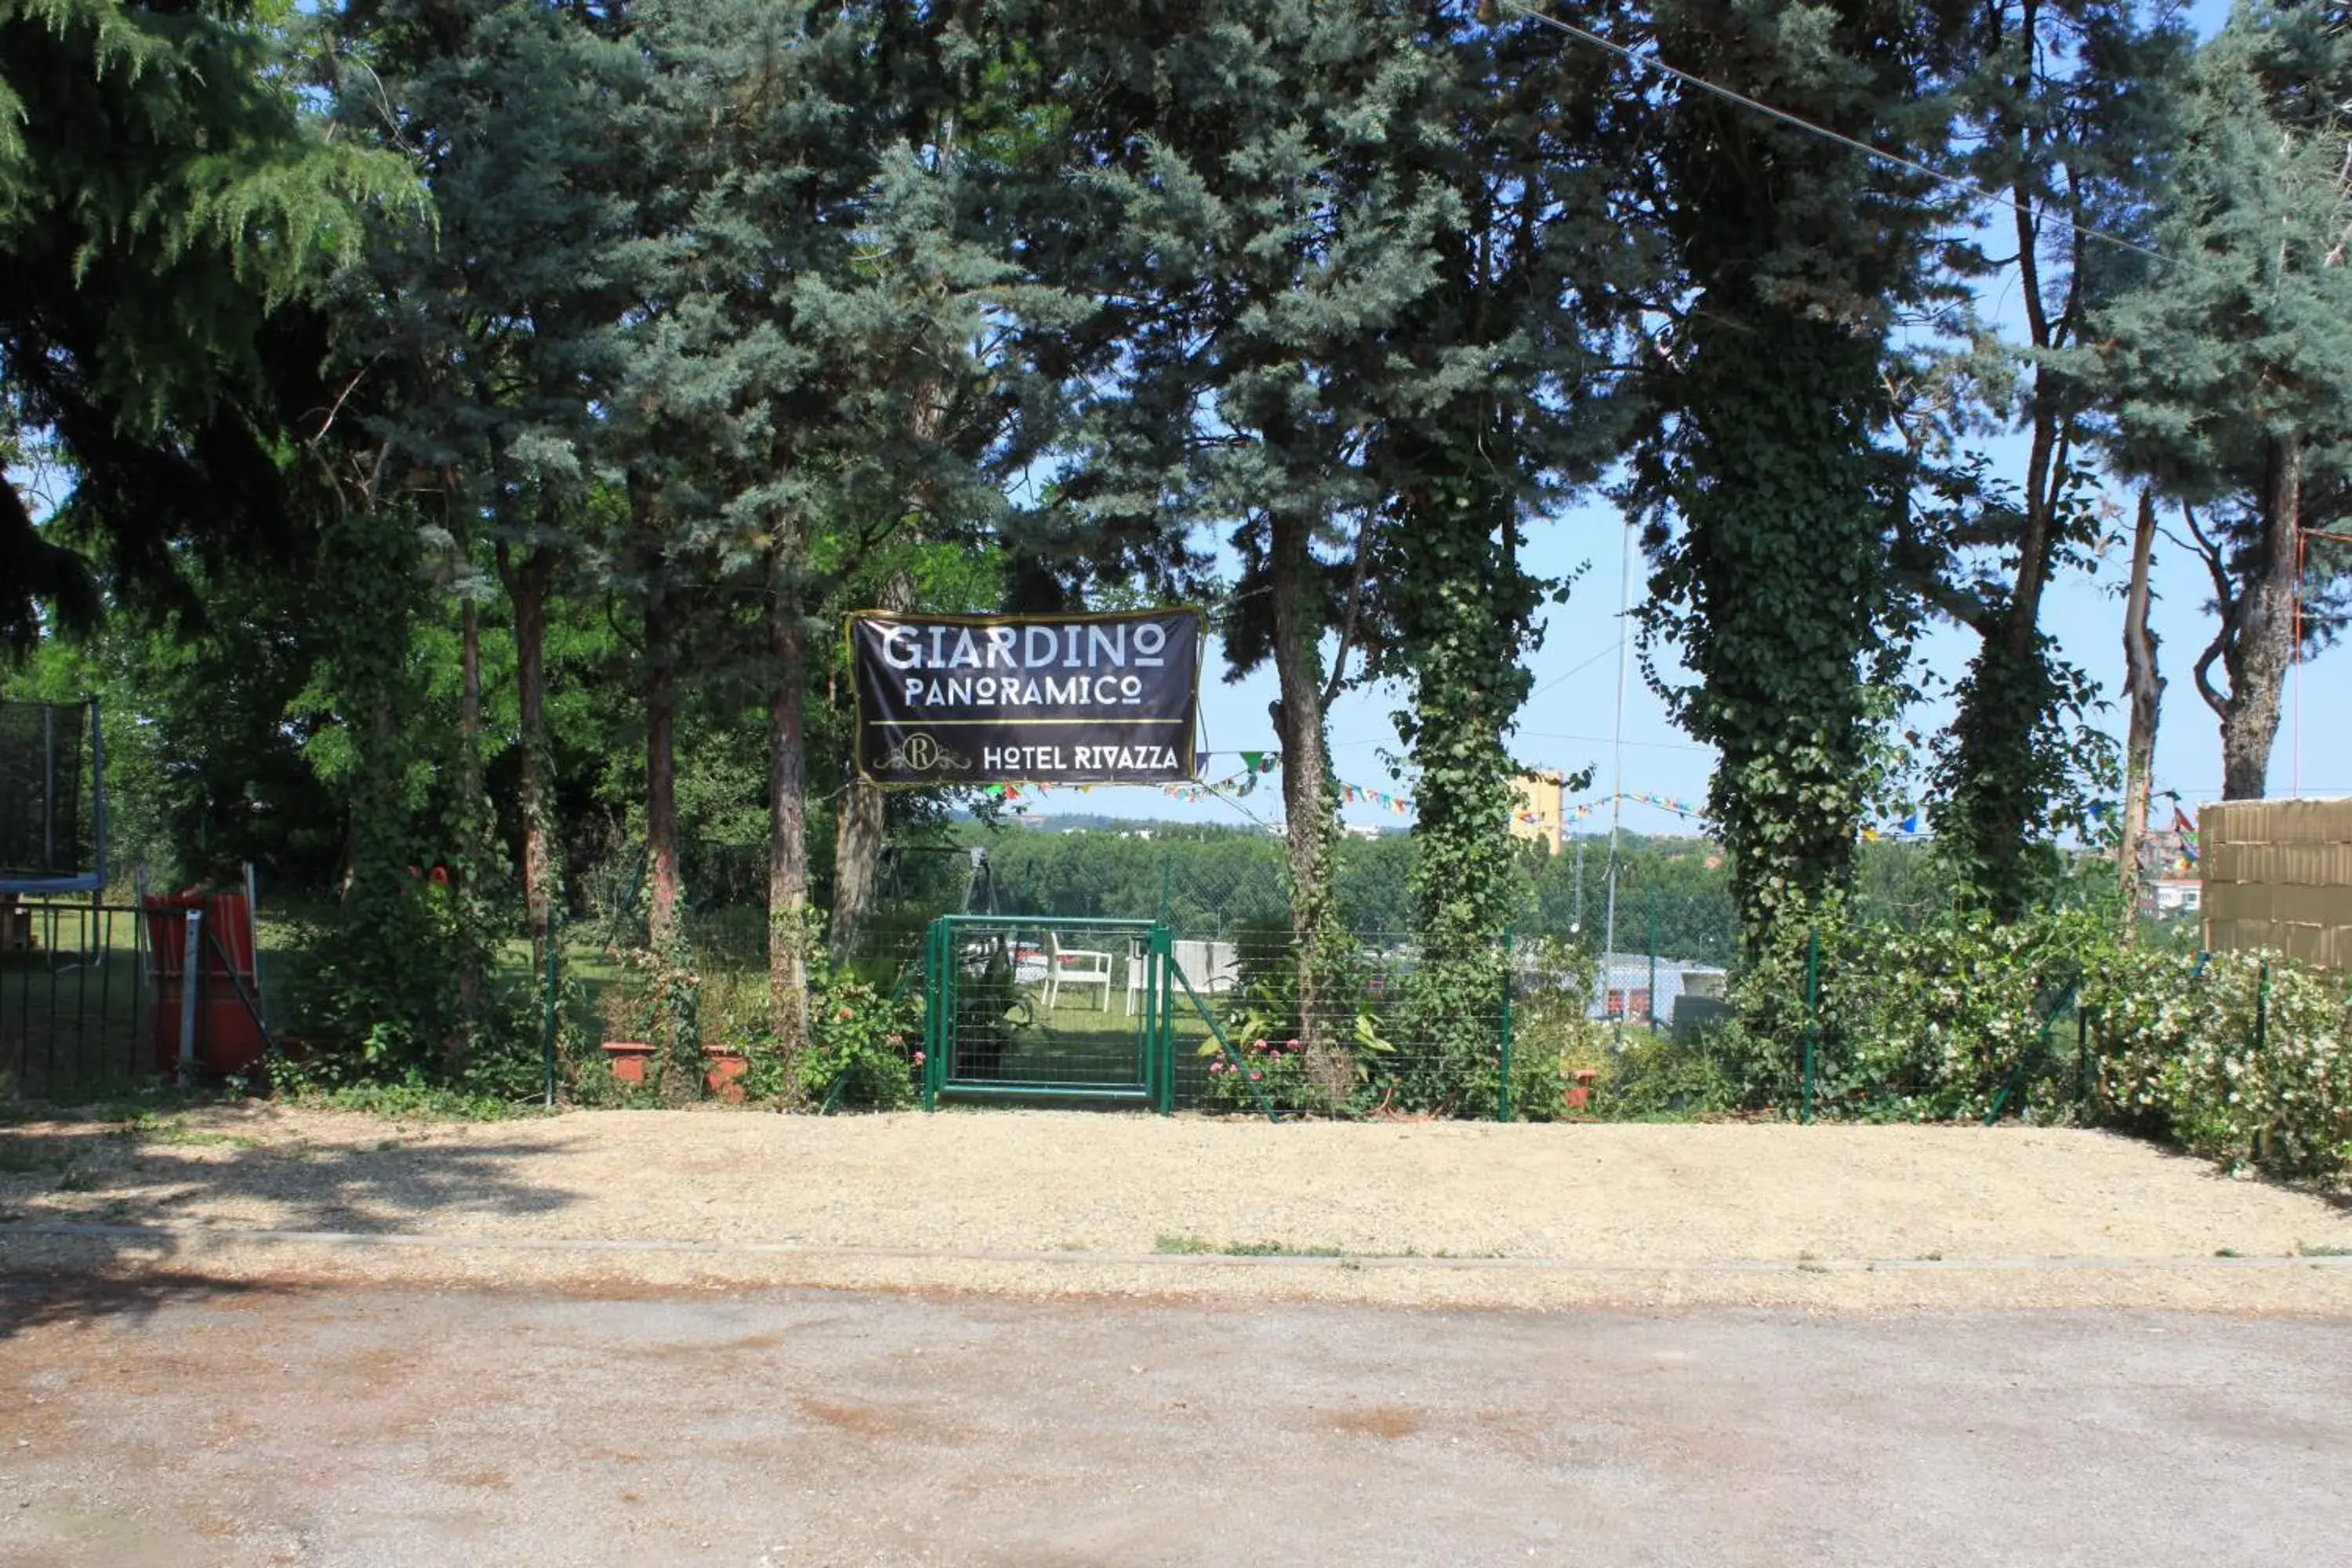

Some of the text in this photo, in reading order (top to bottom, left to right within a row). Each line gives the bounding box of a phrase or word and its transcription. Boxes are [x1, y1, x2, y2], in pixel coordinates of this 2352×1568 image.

[883, 622, 1166, 669] GIARDINO
[905, 675, 1142, 706] PANORAMICO
[983, 746, 1178, 770] HOTEL RIVAZZA
